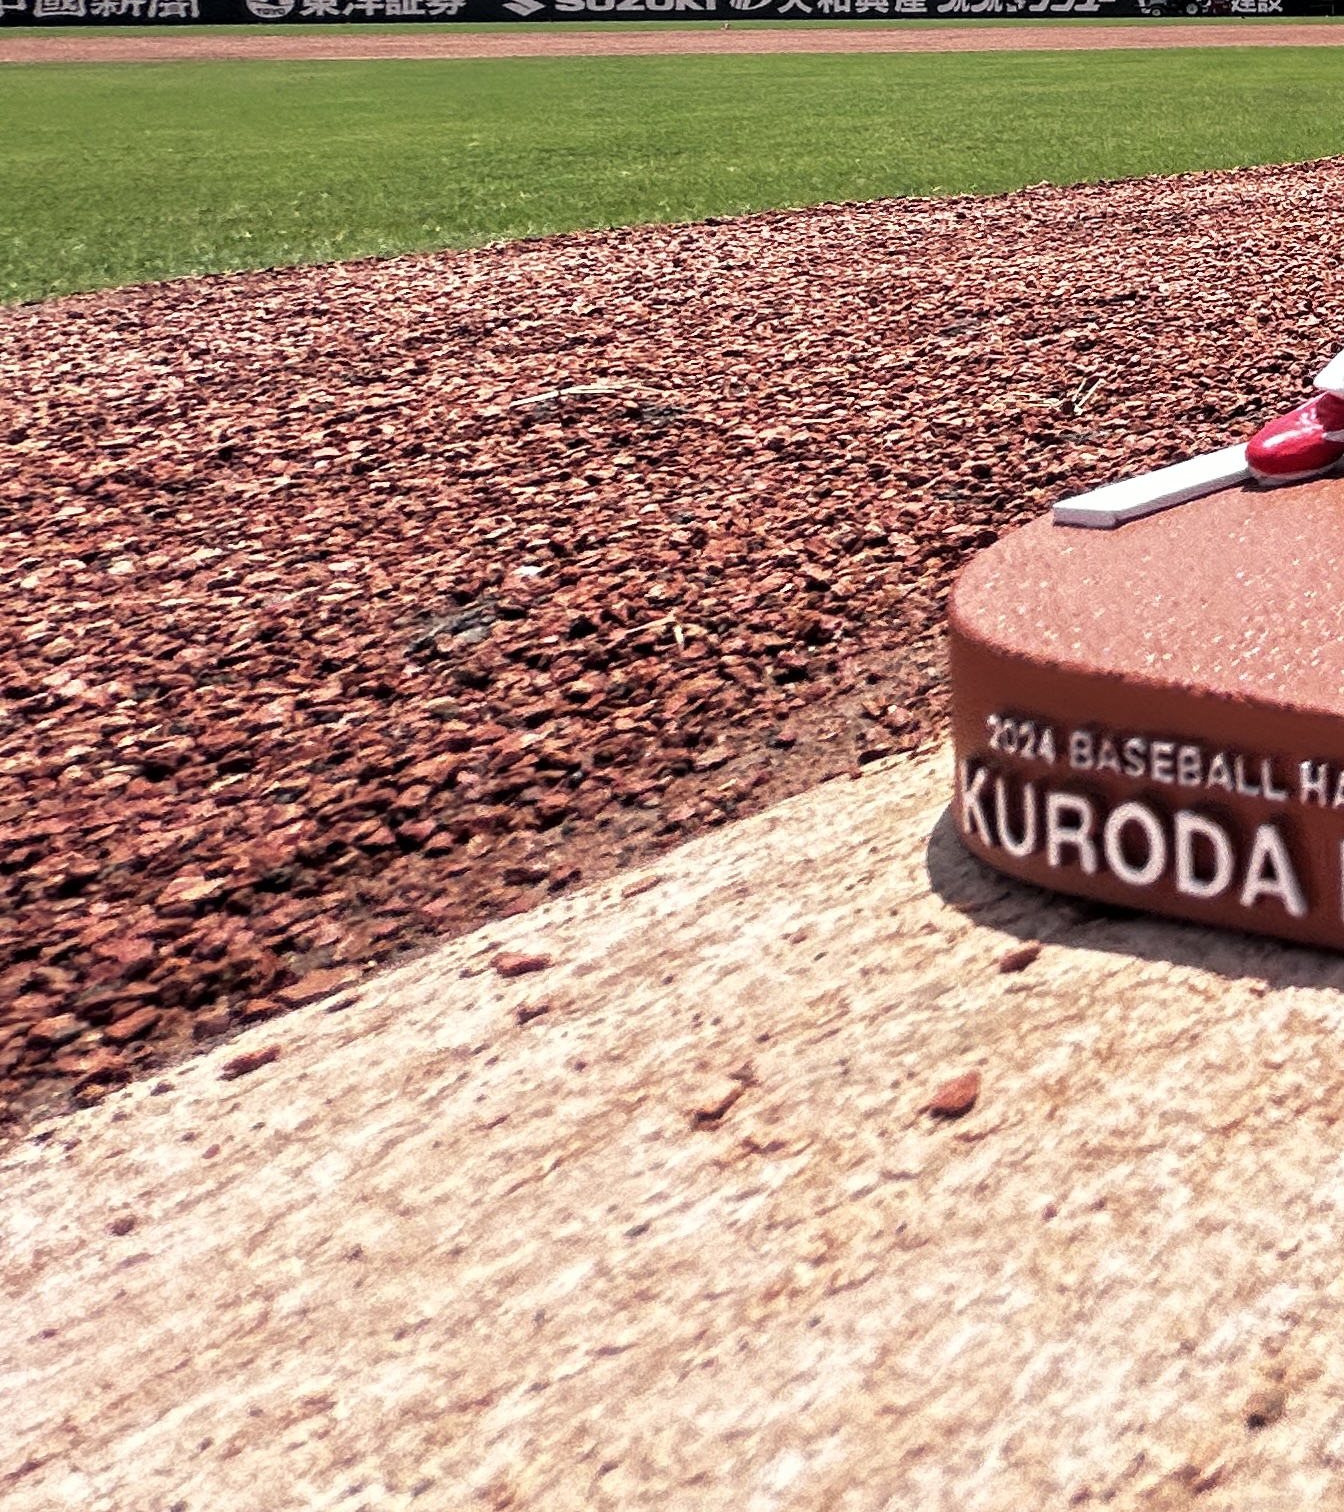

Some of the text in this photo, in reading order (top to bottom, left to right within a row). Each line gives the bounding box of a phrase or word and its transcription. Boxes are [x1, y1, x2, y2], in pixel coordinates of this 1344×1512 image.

[985, 713, 1058, 765] 2024
[1069, 731, 1286, 802] BASEBALL
[960, 762, 1308, 918] KURODA
